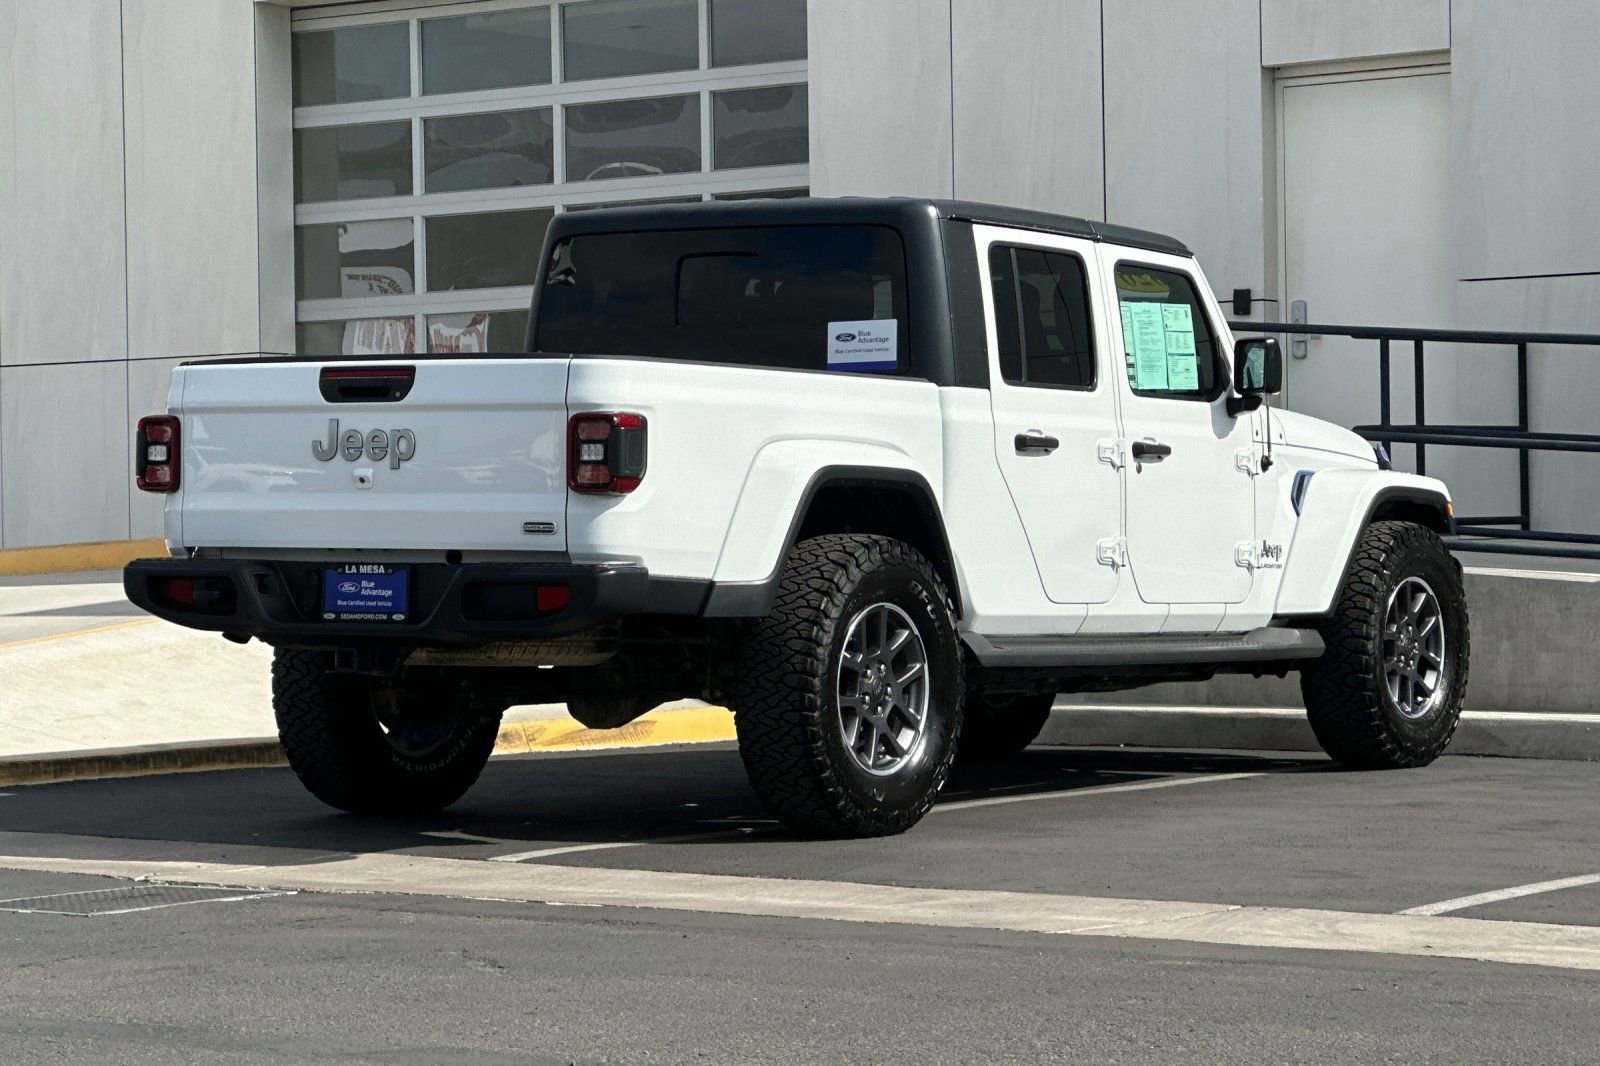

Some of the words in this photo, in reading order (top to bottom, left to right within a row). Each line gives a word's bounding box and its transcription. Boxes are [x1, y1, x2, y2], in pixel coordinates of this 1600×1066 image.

[857, 336, 890, 344] Advantage
[312, 418, 416, 470] Jeep
[345, 564, 357, 574] LA
[359, 564, 385, 574] MESA
[361, 580, 375, 588] Blue
[360, 588, 393, 597] Advantage
